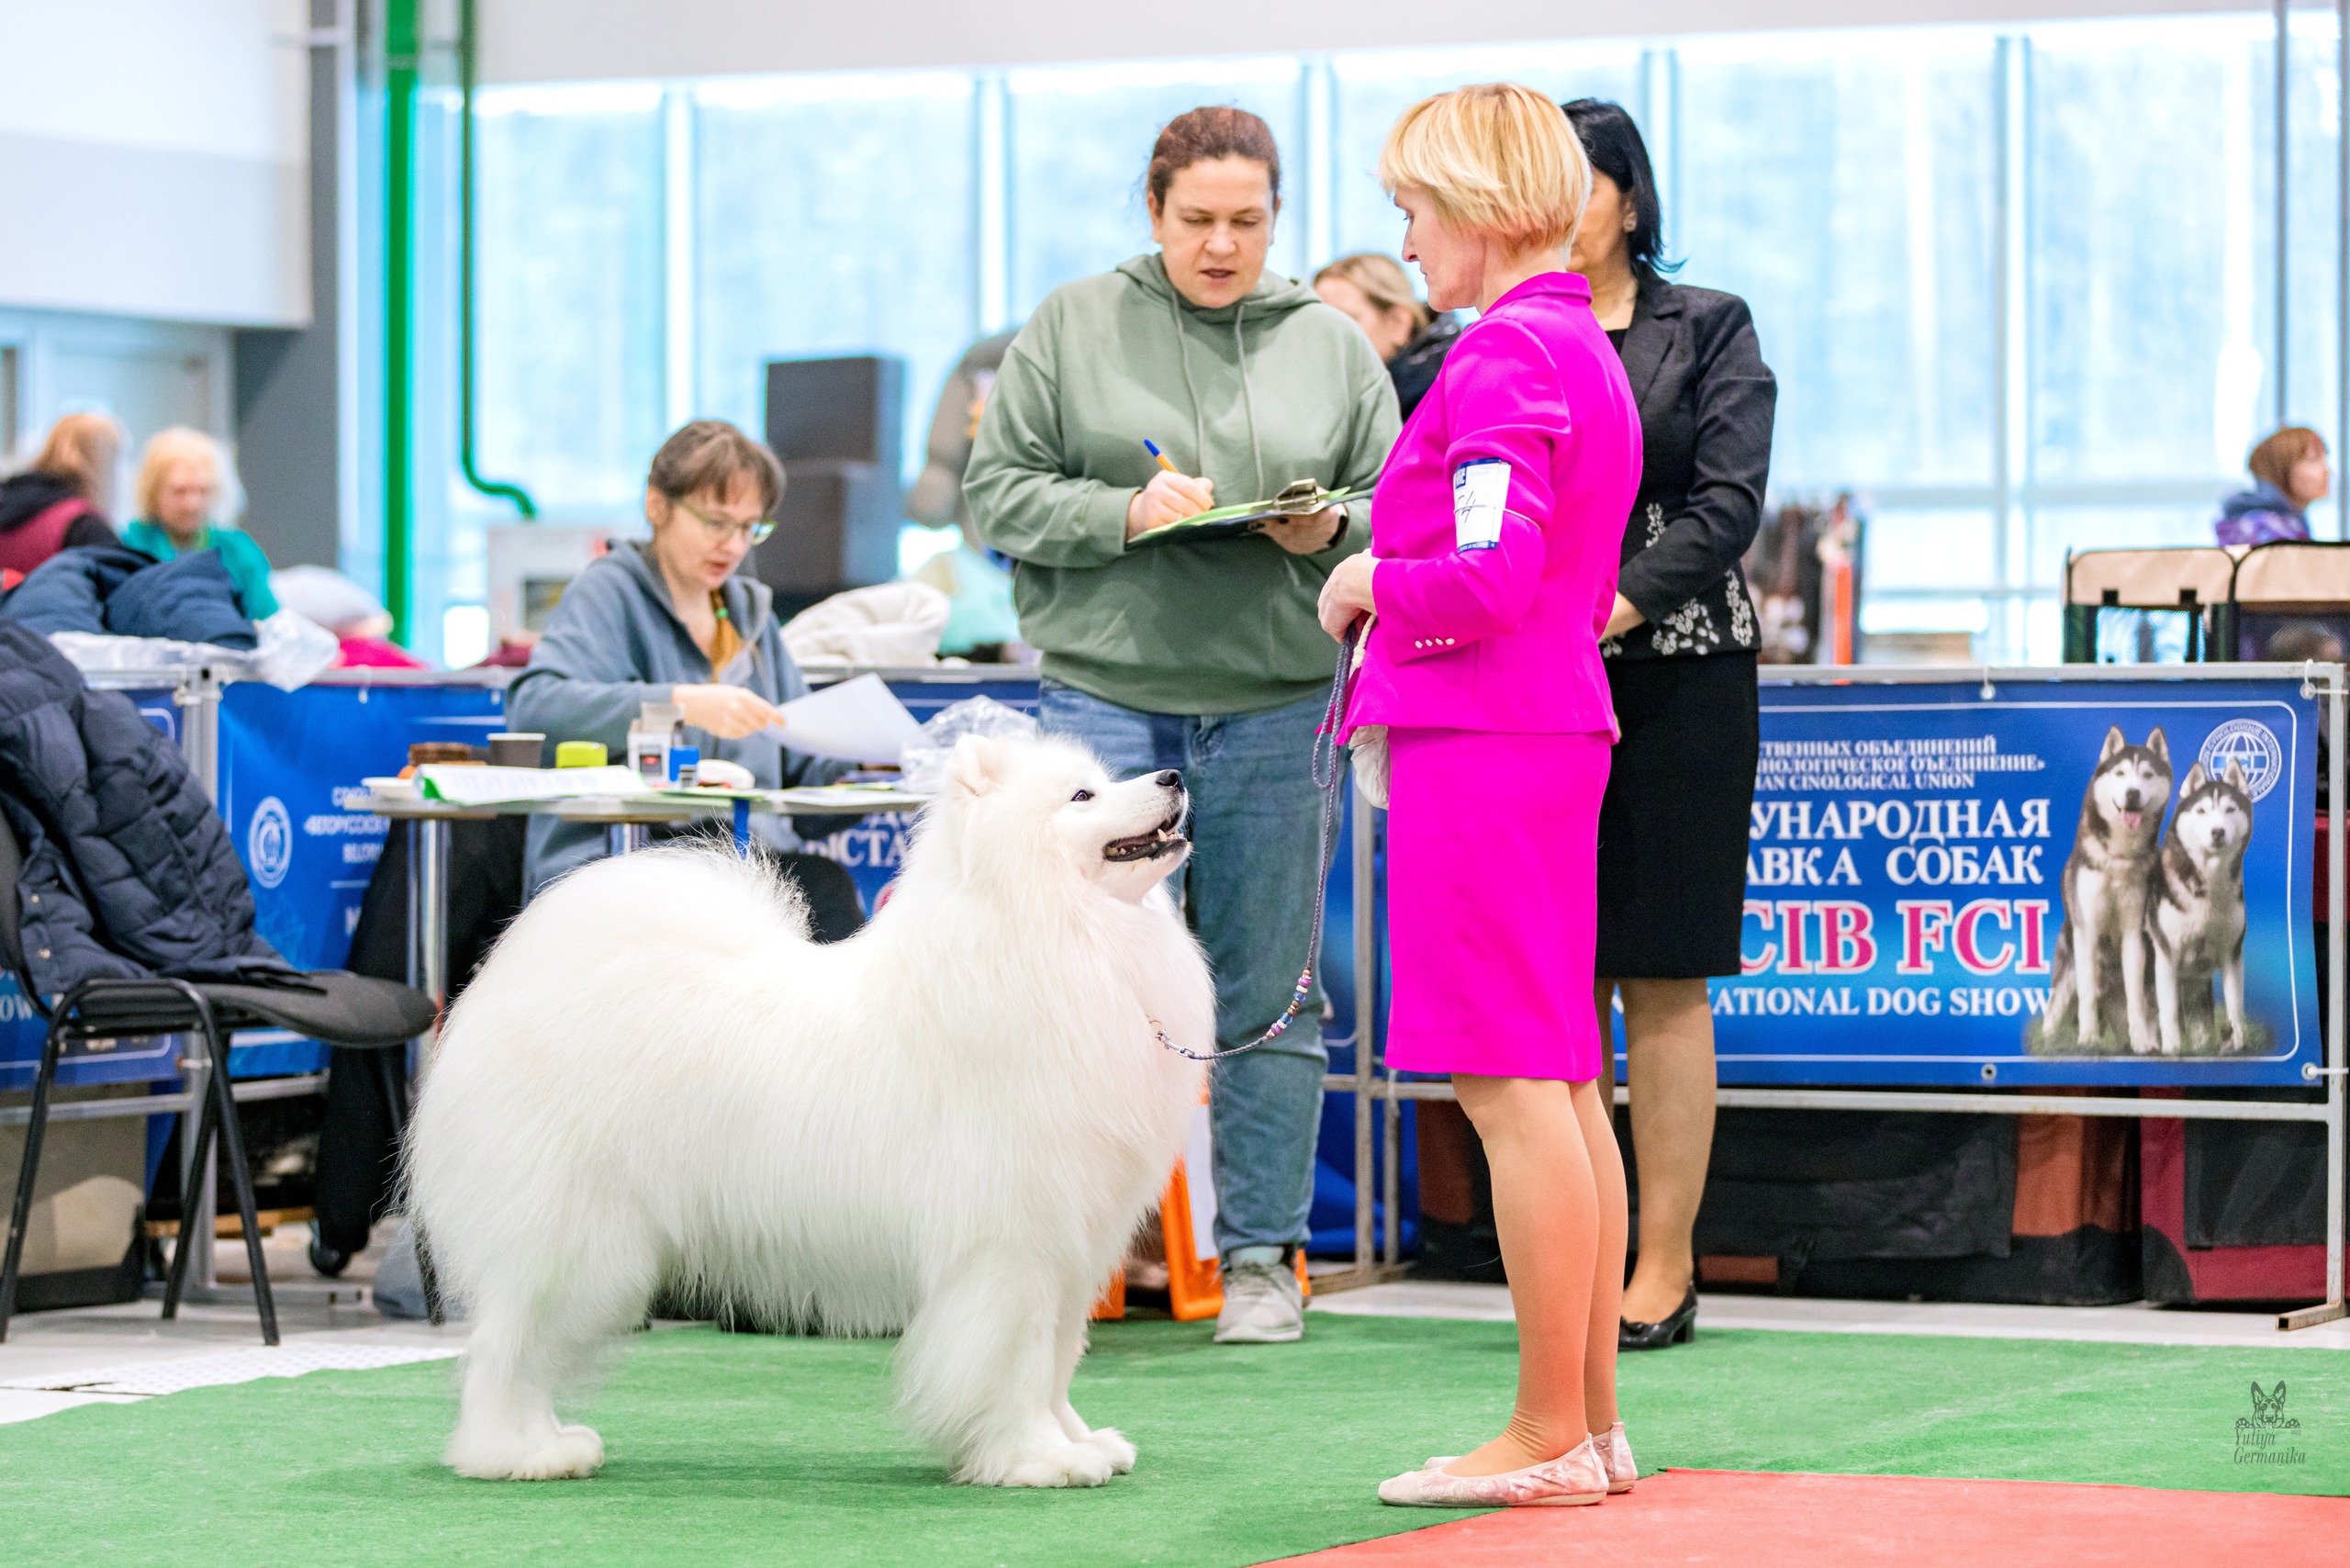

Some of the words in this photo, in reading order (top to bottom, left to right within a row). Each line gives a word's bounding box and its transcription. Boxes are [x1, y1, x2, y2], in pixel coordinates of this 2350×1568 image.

[1760, 740, 1851, 757] ТВЕННЫХ
[1789, 773, 1911, 790] CINOLOGICAL
[1915, 772, 1975, 790] UNION
[1886, 845, 2044, 886] СОБАК
[1896, 898, 2052, 976] FCI
[1707, 987, 1860, 1016] ATIONAL
[1866, 987, 1943, 1016] DOG
[1949, 987, 2055, 1016] SHOW
